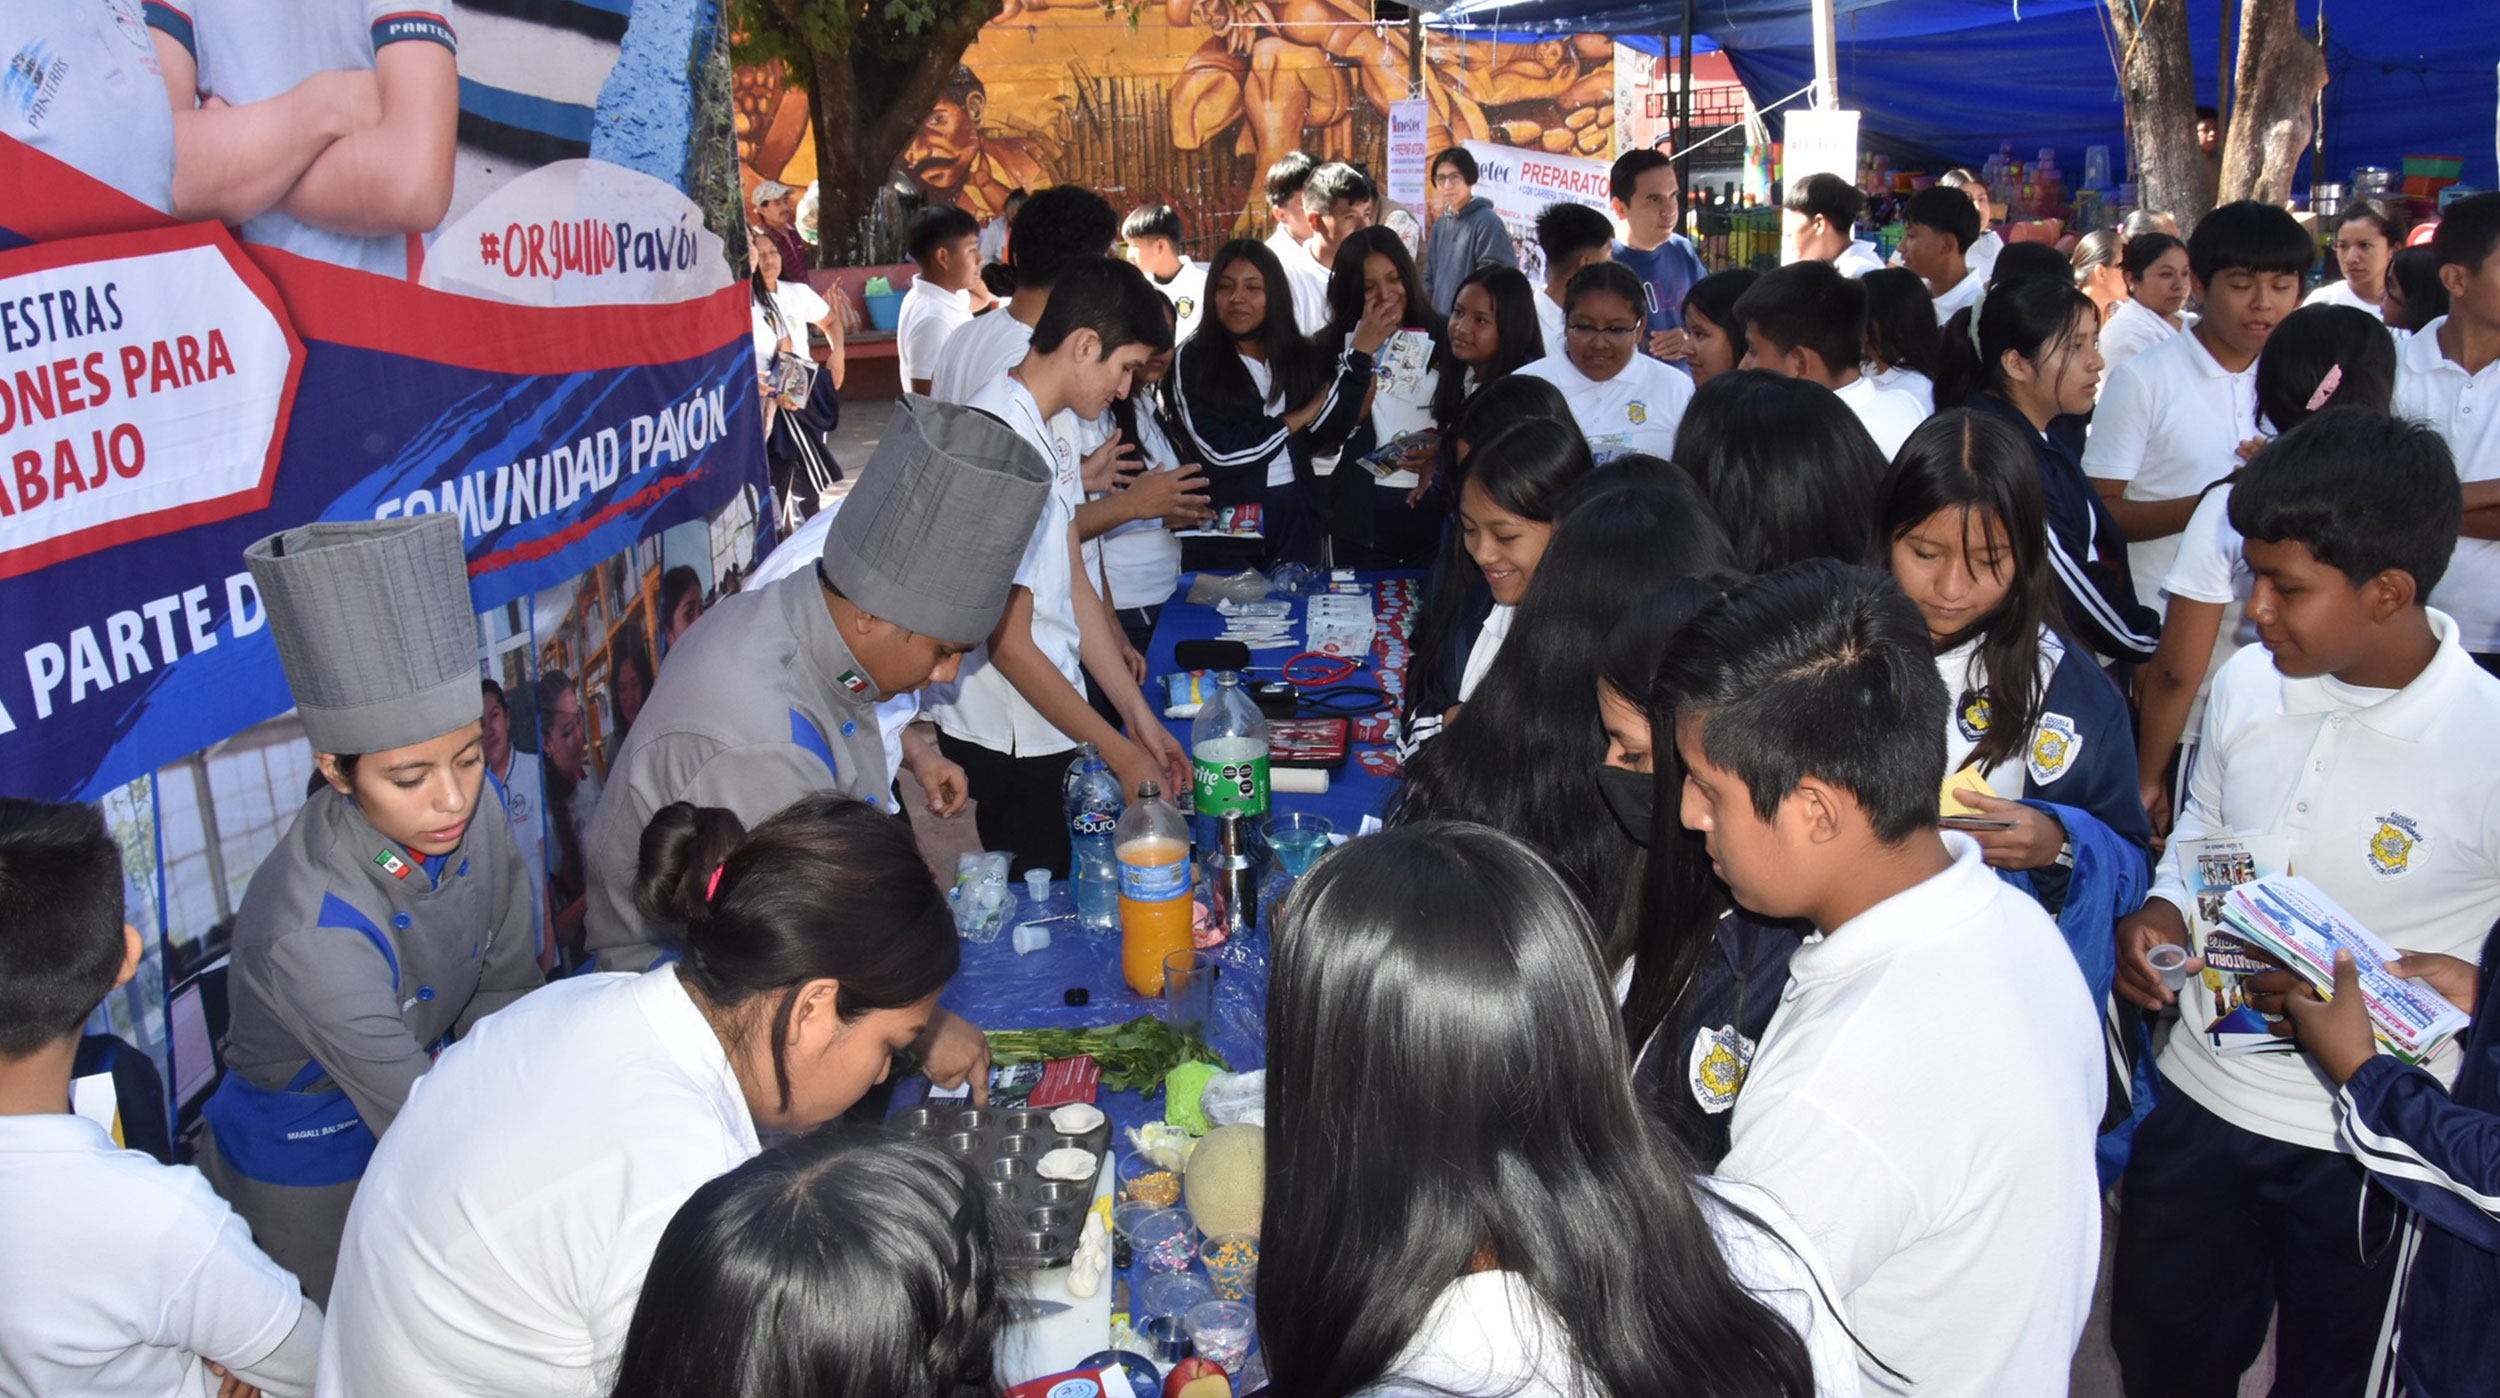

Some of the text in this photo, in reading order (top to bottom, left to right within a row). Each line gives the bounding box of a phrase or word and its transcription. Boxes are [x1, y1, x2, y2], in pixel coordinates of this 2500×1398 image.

[27, 57, 70, 130] PANTERAS
[119, 328, 236, 398] PARA
[630, 385, 728, 475] PAVÓN
[24, 584, 219, 720] PARTE
